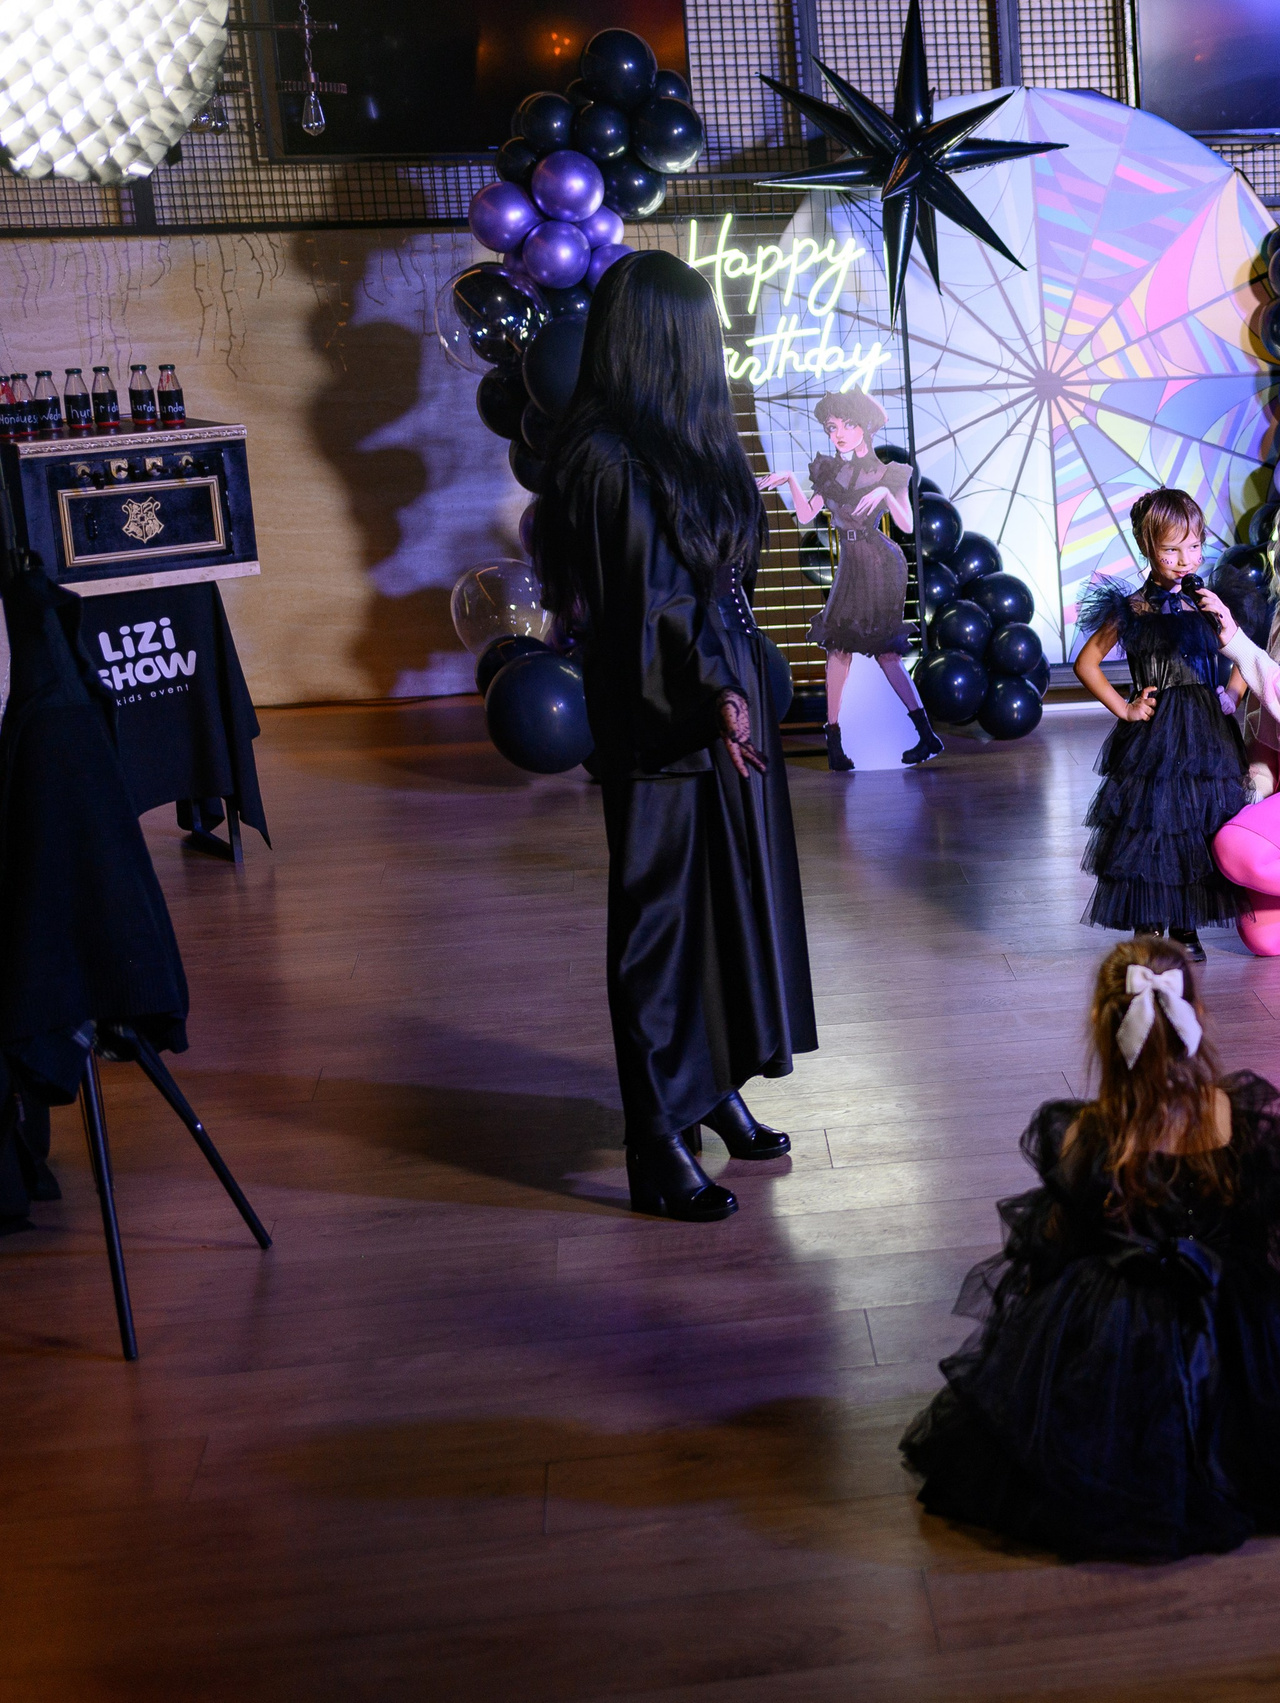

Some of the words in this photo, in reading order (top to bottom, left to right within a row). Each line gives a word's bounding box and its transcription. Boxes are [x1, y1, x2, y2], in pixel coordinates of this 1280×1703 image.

[688, 212, 867, 330] Happy
[723, 312, 893, 395] irthday
[116, 694, 142, 707] kids
[150, 683, 189, 698] event
